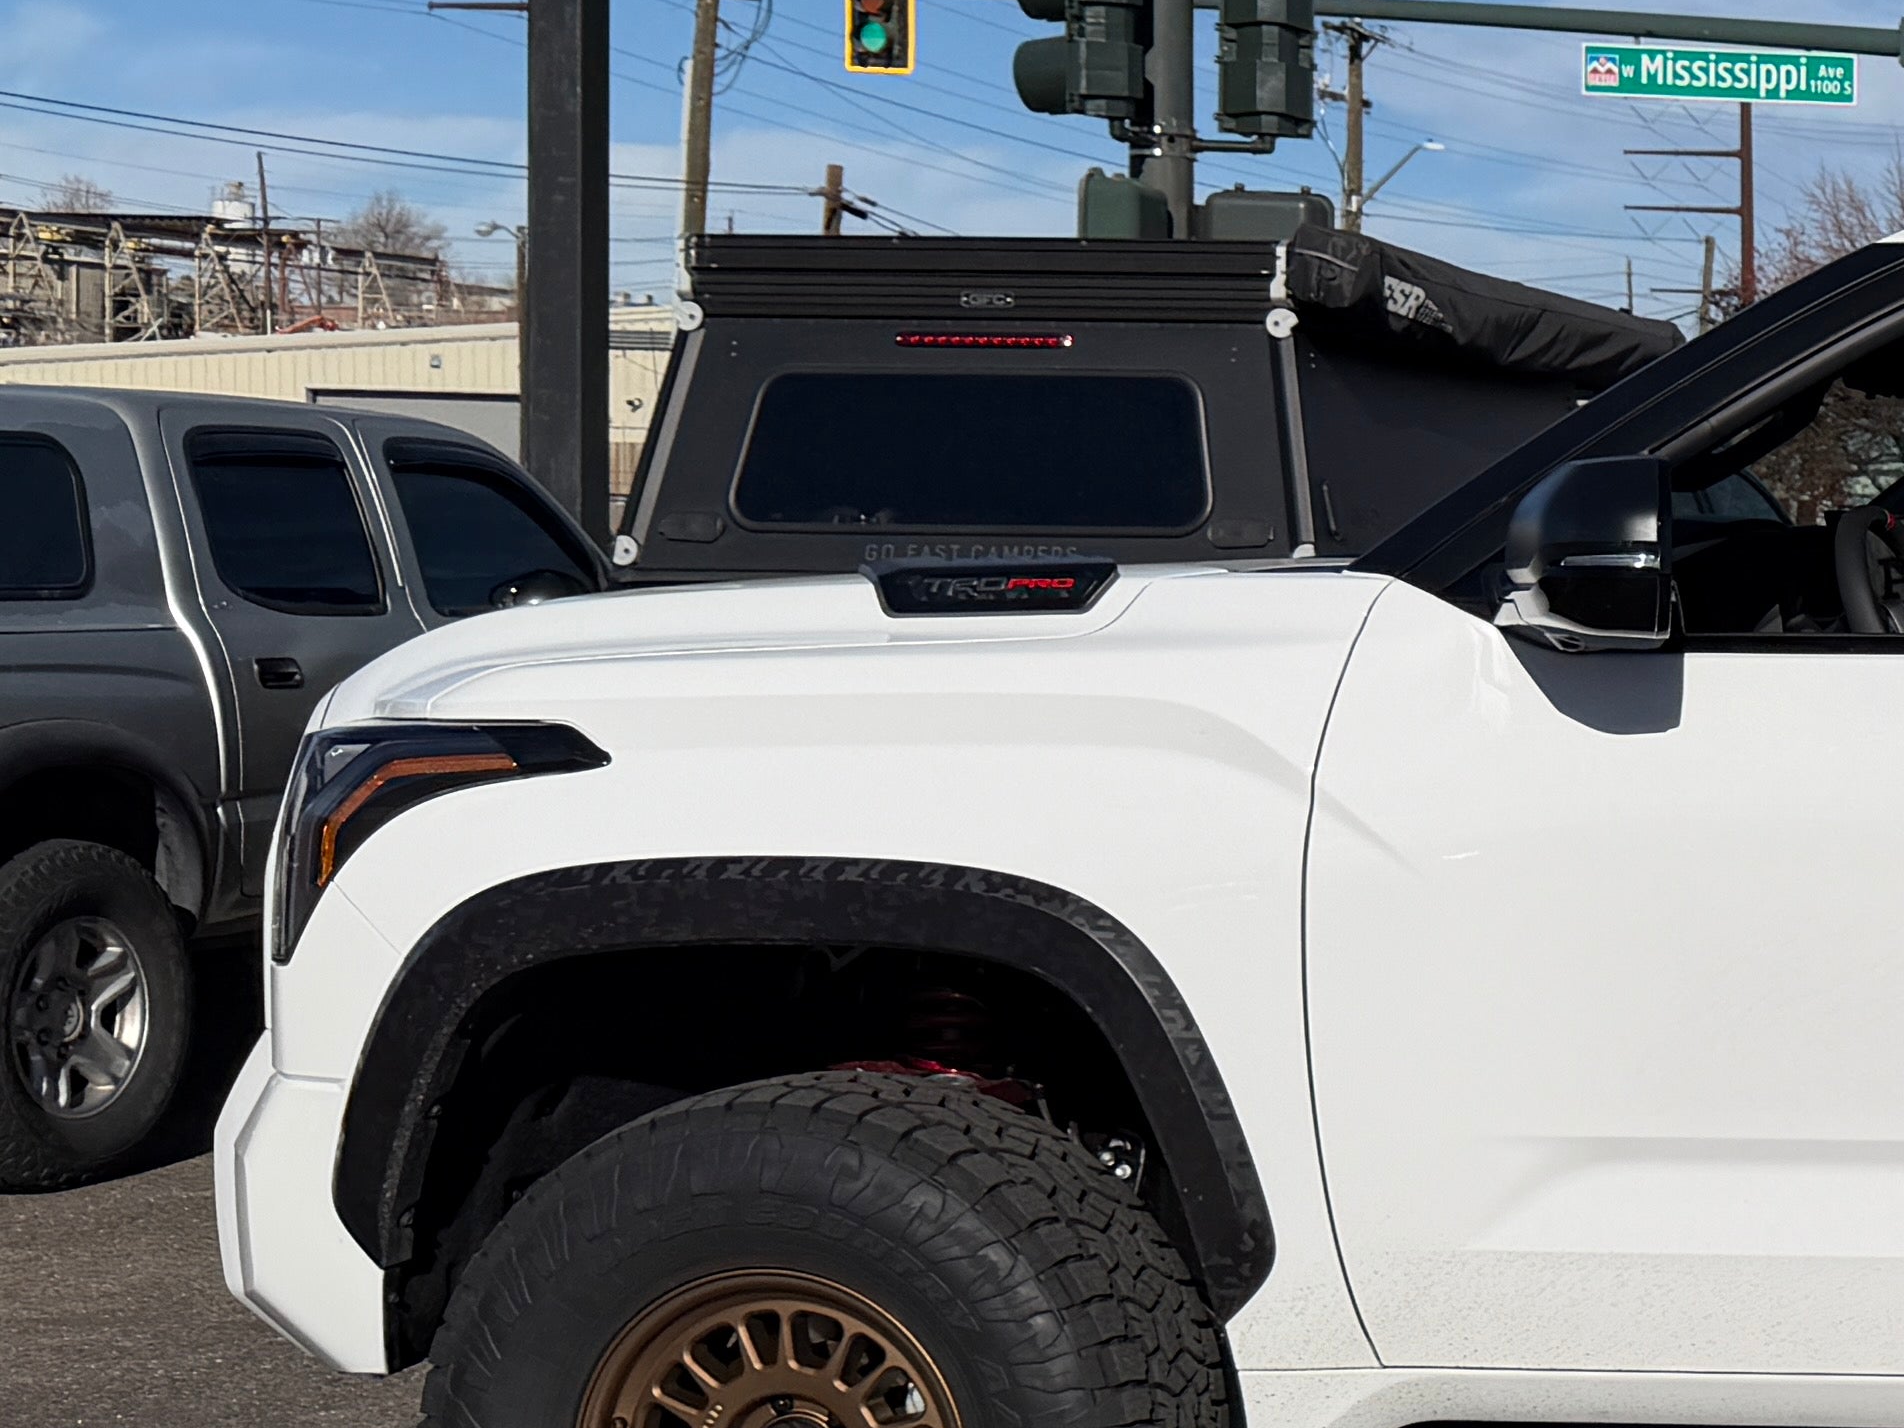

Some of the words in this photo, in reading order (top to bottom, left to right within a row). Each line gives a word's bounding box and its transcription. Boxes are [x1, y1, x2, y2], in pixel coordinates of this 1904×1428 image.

[1640, 50, 1807, 99] Mississippi
[1818, 64, 1844, 79] Ave
[1810, 79, 1840, 95] 1100
[1843, 80, 1852, 95] S
[864, 544, 895, 561] GO
[906, 544, 961, 559] FAST
[1007, 577, 1075, 590] PRO
